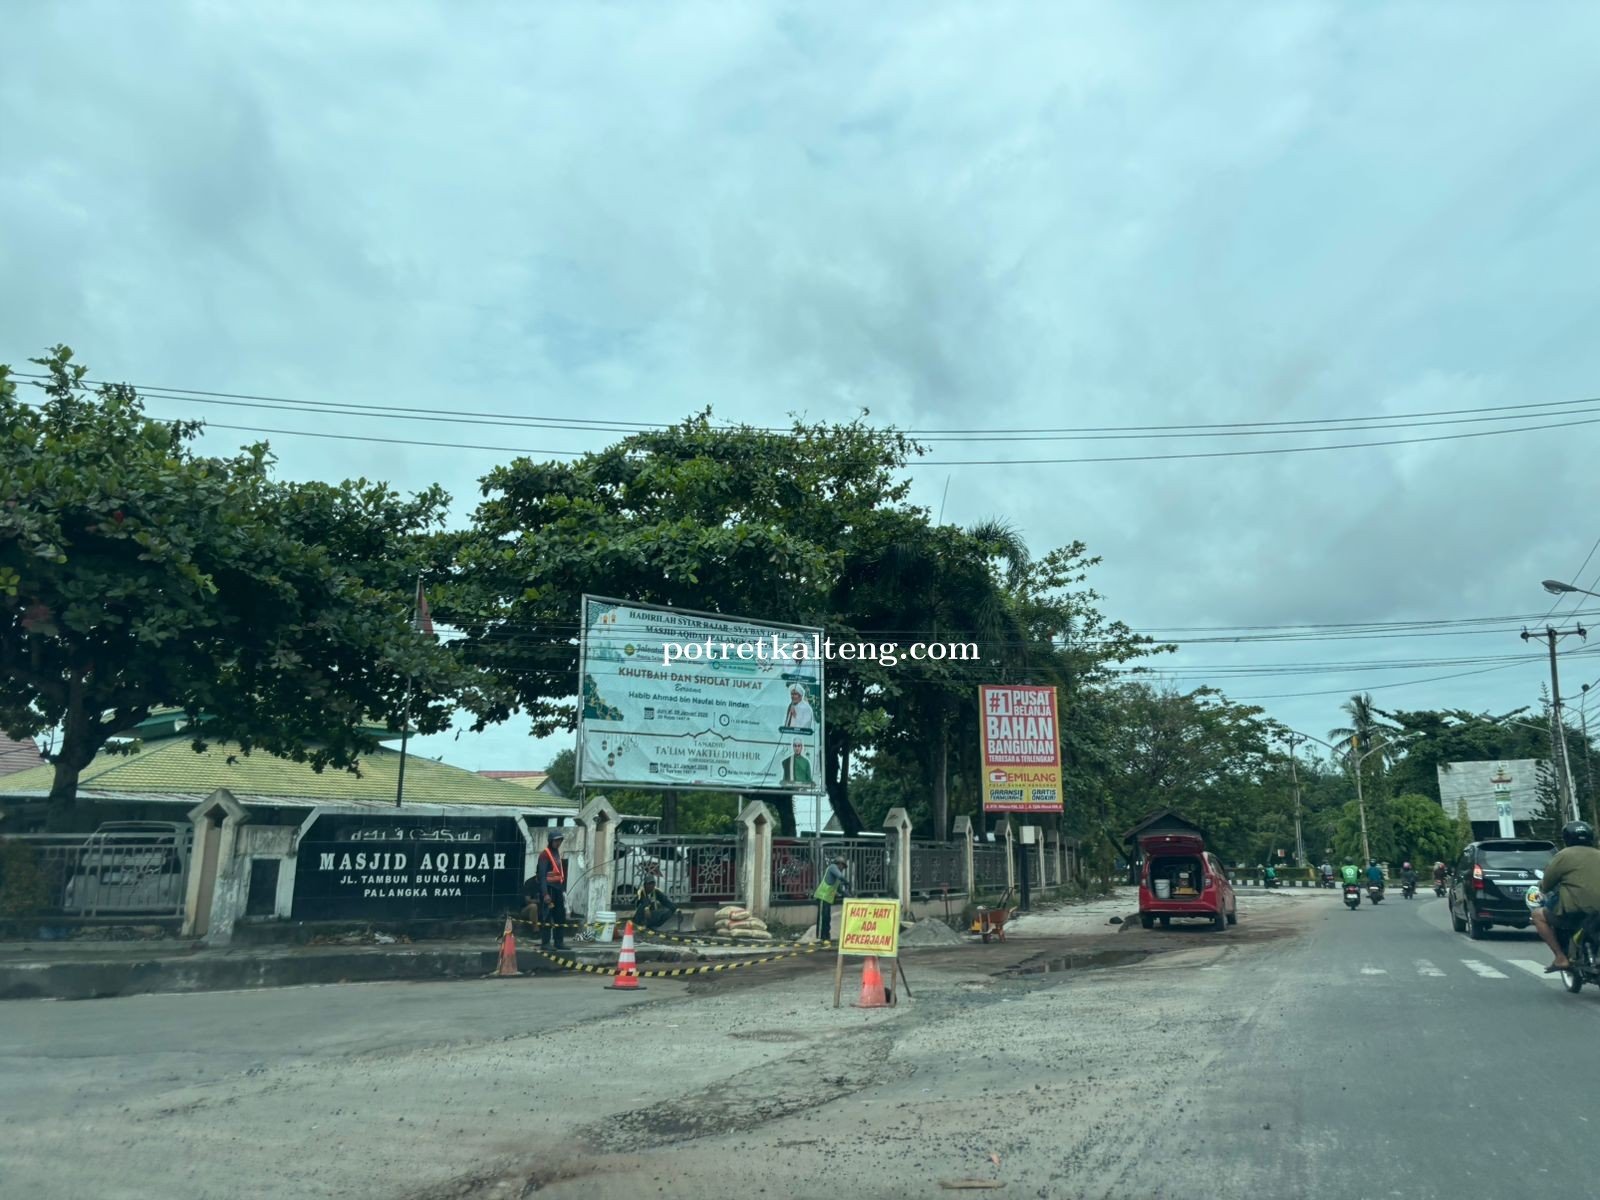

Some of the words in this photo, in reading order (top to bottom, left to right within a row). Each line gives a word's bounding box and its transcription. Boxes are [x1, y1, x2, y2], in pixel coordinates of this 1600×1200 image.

[629, 611, 676, 625] HADIRILAH
[618, 667, 668, 681] KHUTBAH
[670, 672, 692, 683] DAN
[694, 676, 730, 688] SHOLAT
[732, 679, 762, 690] JUM'AT
[628, 691, 651, 700] Habib
[652, 694, 678, 703] Ahmad
[679, 695, 691, 703] bin
[715, 698, 727, 707] bin
[990, 691, 1010, 713] #1
[1013, 690, 1051, 706] PUSAT
[1014, 705, 1052, 717] BELANJA
[987, 716, 1054, 740] BAHAN
[655, 745, 686, 756] TA'LIM
[687, 747, 720, 759] WAKTU
[721, 749, 761, 761] DHUHUR
[988, 740, 1055, 755] BANGUNAN
[319, 852, 408, 871] MASJID
[420, 852, 506, 873] AQIDAH
[340, 875, 357, 884] JL.
[361, 875, 408, 884] TAMBUN
[416, 874, 460, 884] BUNGAI
[364, 888, 428, 897] PALANGKA
[434, 887, 462, 897] RAYA
[861, 920, 877, 932] ADA
[844, 933, 892, 946] PEKERJAAN
